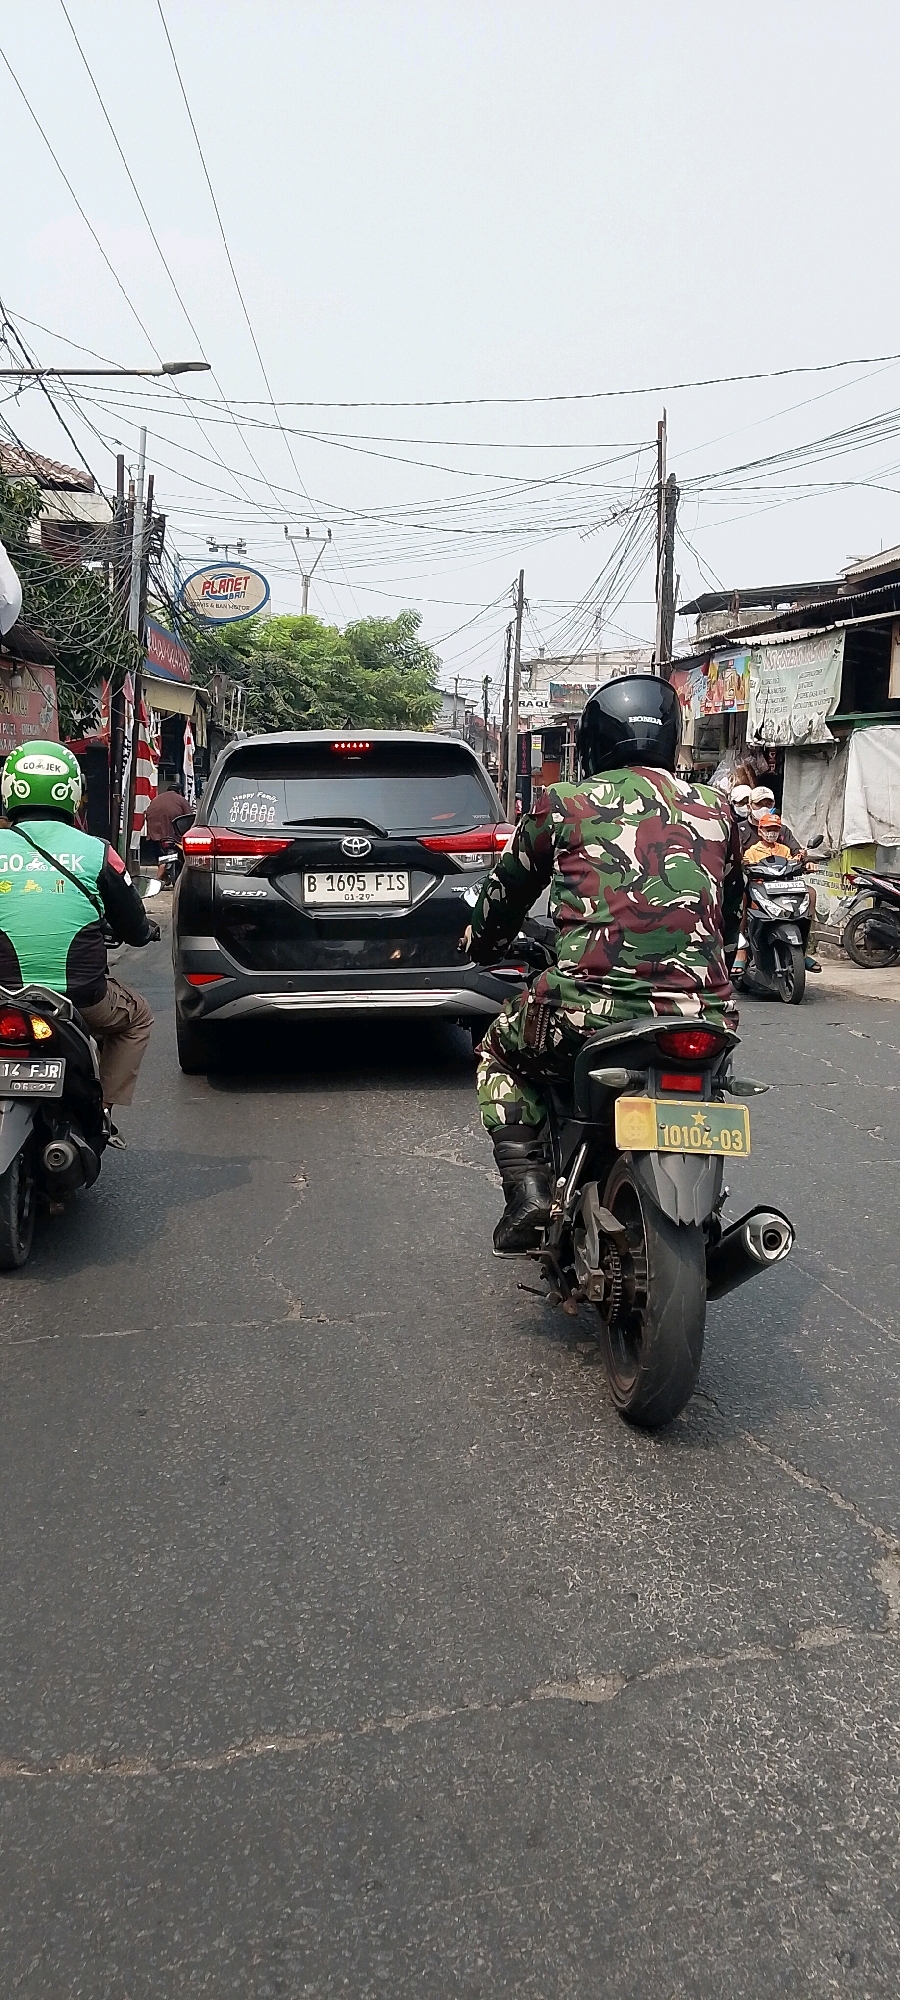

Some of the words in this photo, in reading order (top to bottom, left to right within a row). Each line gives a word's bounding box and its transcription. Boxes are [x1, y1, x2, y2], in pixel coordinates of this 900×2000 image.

[201, 575, 251, 596] PLANET
[228, 591, 246, 599] BAN
[628, 715, 663, 726] HONDA
[23, 762, 35, 770] GO
[46, 763, 62, 773] JEK
[231, 792, 255, 802] Happy
[256, 791, 279, 804] Family
[0, 853, 24, 872] GO
[307, 875, 317, 893] B
[325, 874, 367, 892] 1695
[375, 874, 406, 891] FIS
[222, 889, 268, 898] Rush
[29, 1064, 59, 1078] FJR
[663, 1124, 743, 1151] 10104-03
